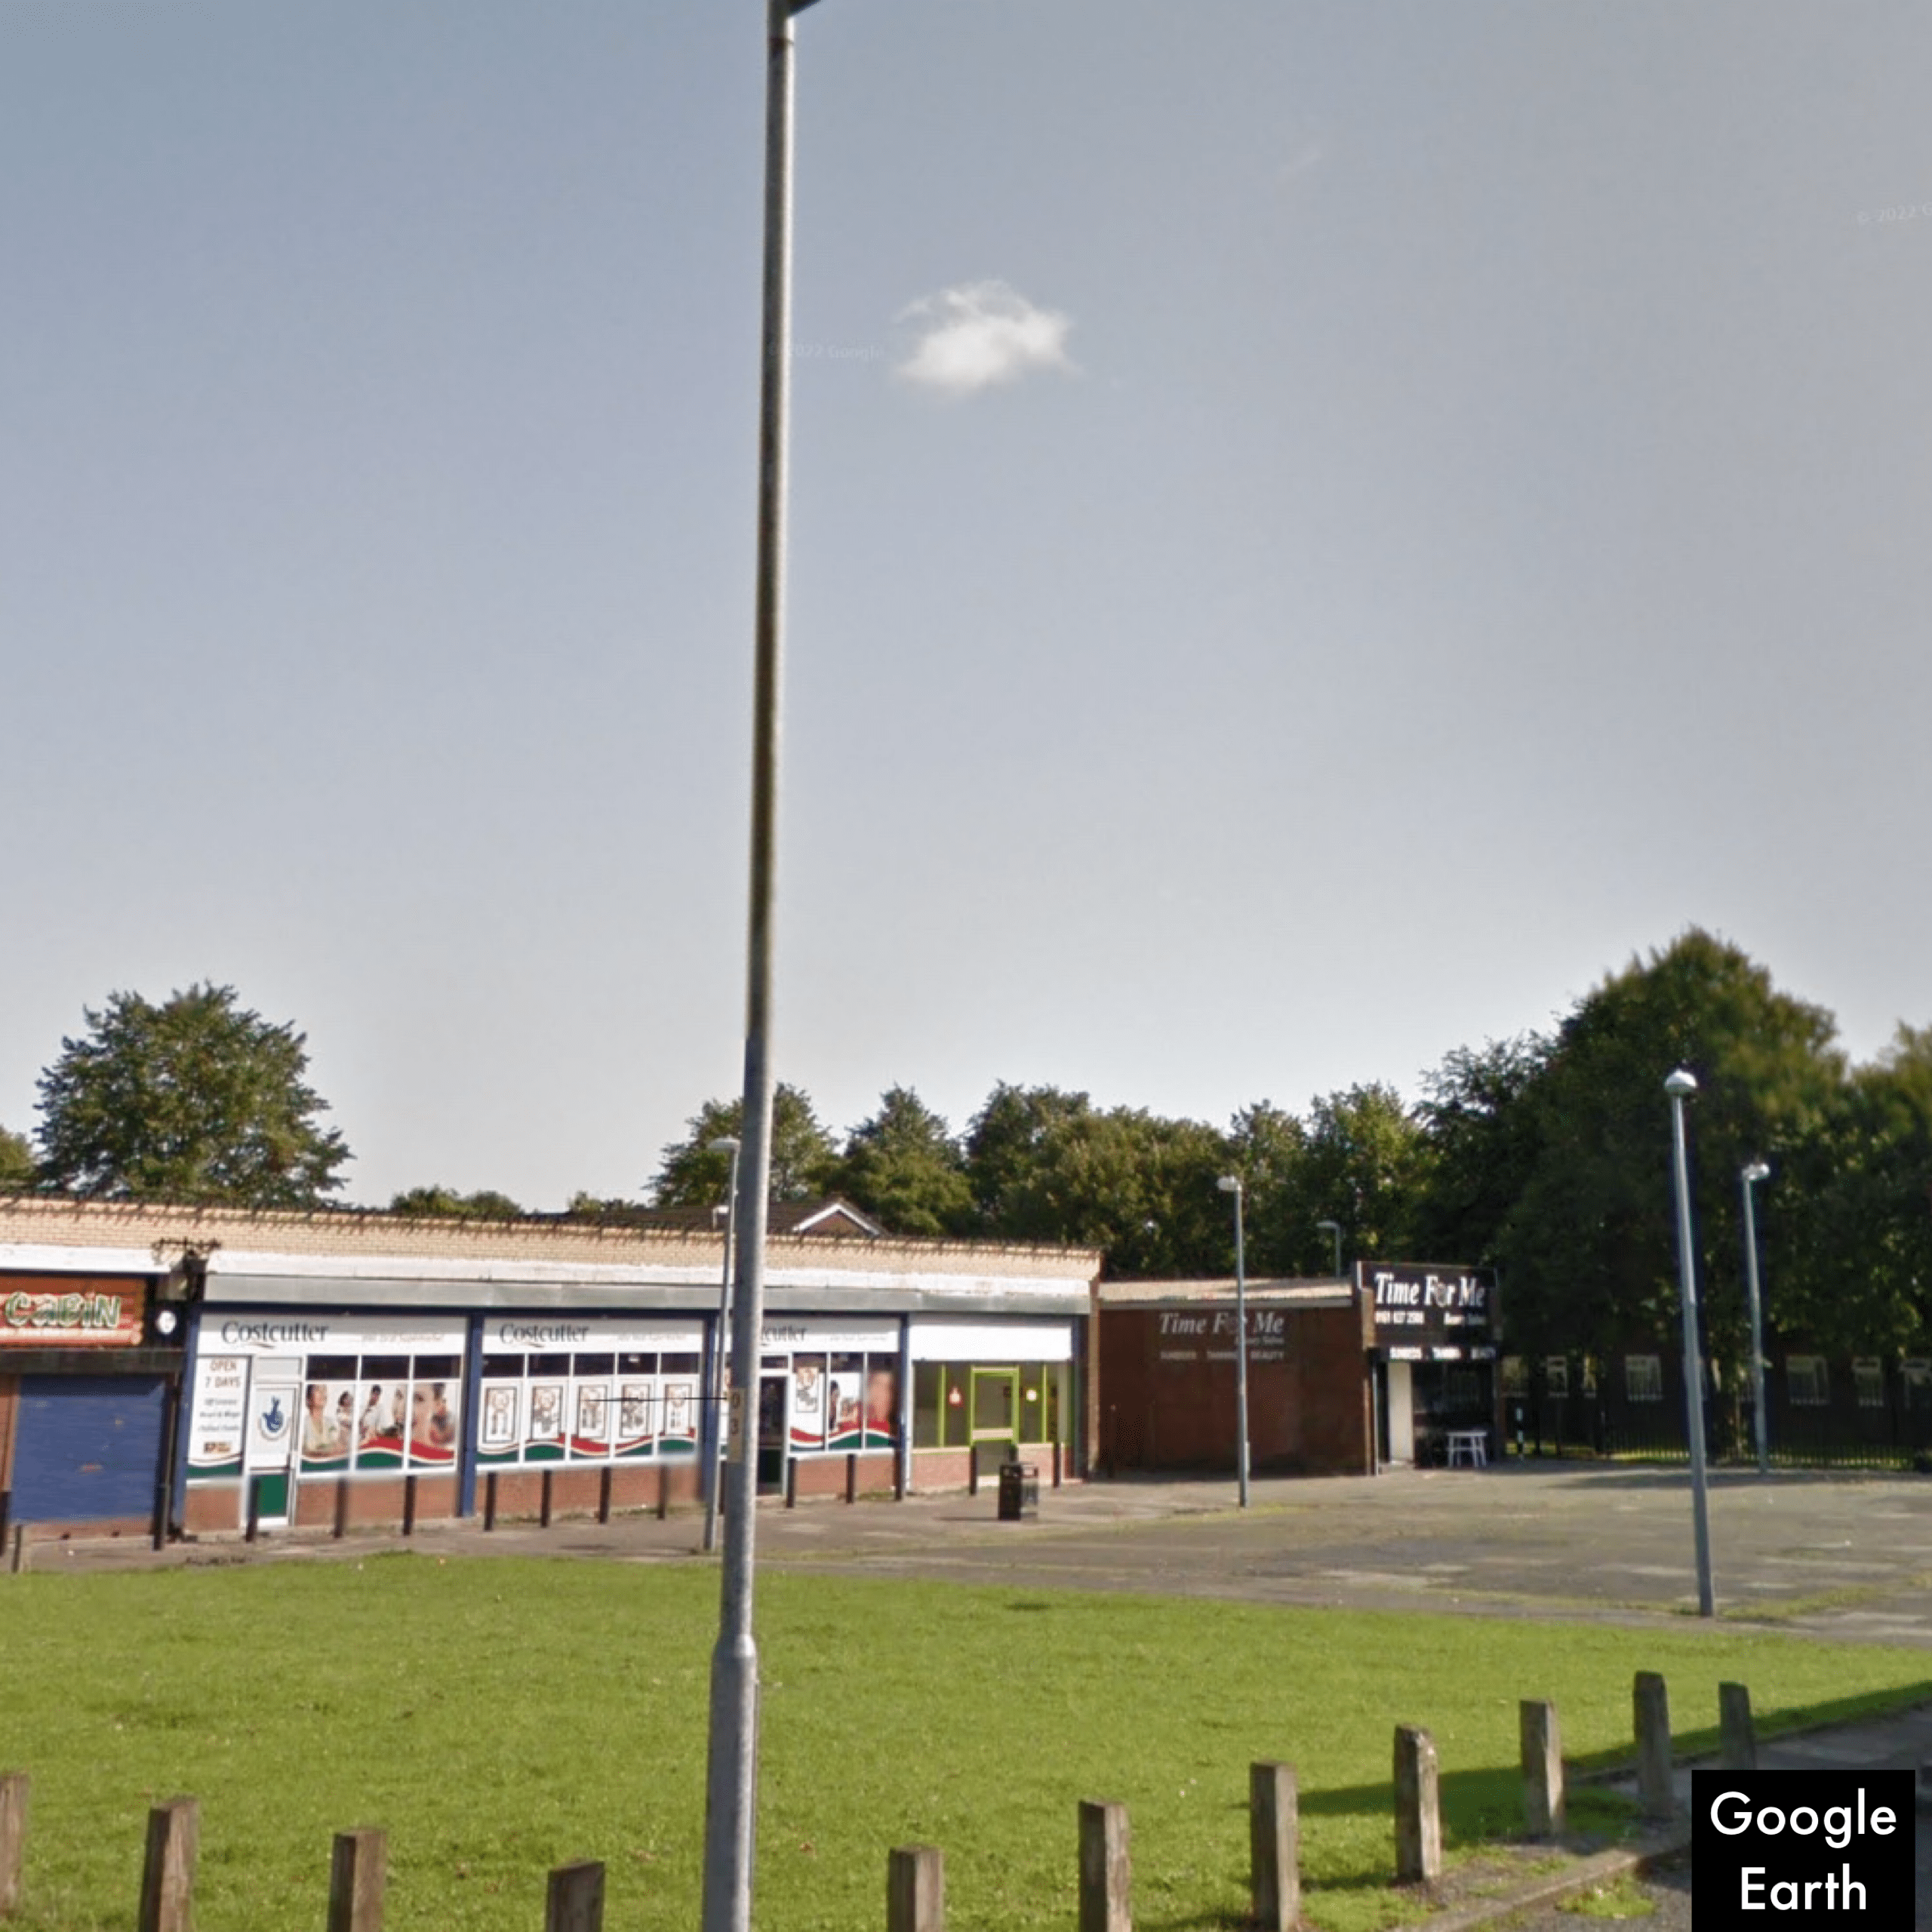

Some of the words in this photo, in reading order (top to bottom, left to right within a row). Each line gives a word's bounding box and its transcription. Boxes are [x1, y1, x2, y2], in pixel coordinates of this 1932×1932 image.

[1375, 1272, 1420, 1305] Time
[1424, 1274, 1457, 1307] For
[1458, 1275, 1485, 1307] Me
[221, 1320, 329, 1344] Costcutter
[500, 1324, 590, 1344] Costcutter
[1159, 1312, 1208, 1335] Time
[1253, 1311, 1284, 1335] Me
[210, 1358, 238, 1371] OPEN
[214, 1376, 241, 1389] DAYS
